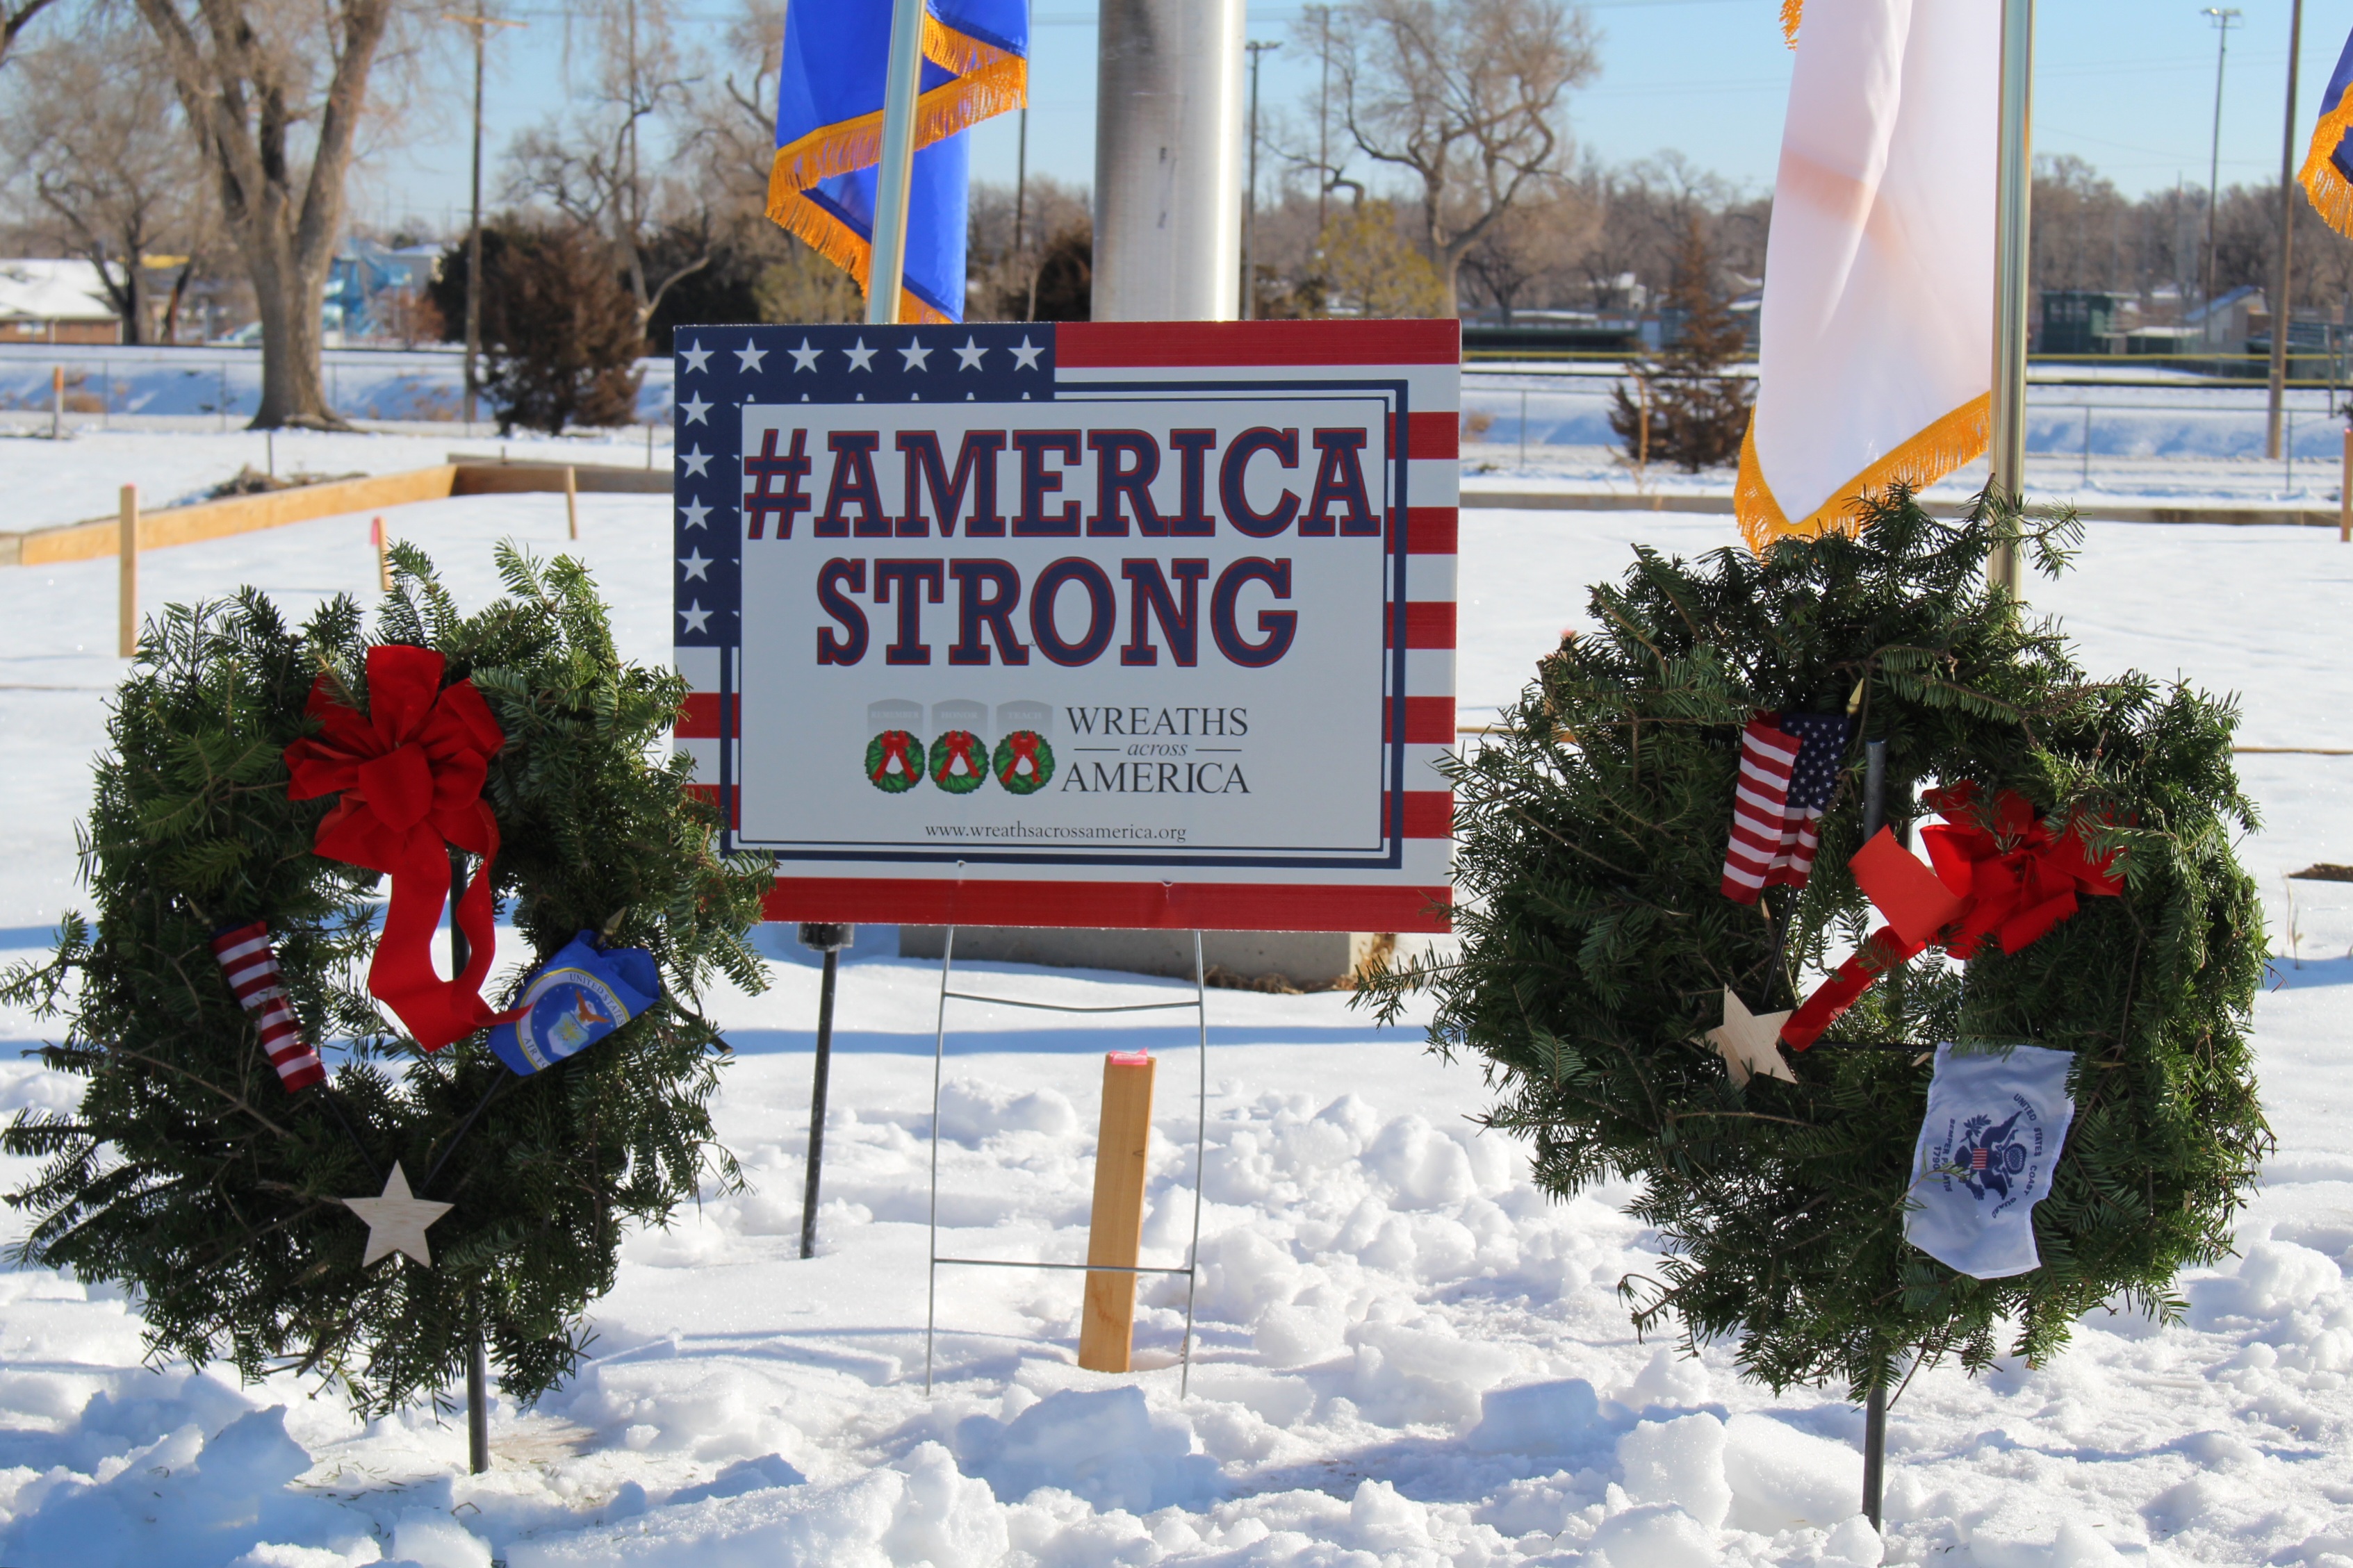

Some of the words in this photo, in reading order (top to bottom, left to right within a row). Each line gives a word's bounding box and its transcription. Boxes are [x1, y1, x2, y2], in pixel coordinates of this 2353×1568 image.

[744, 427, 1381, 540] #AMERICA
[817, 556, 1297, 668] STRONG
[1008, 711, 1042, 720] TEACH
[1065, 707, 1248, 736] WREATHS
[1127, 743, 1188, 757] across
[1060, 761, 1252, 793] AMERICA
[925, 820, 1187, 843] www.wreathsacrossamerica.org
[570, 973, 604, 994] UNITED
[602, 993, 625, 1025] STATES
[523, 1038, 537, 1056] AIR
[2013, 1093, 2037, 1121] UNITED
[1942, 1118, 1956, 1155] SEMPER
[2033, 1127, 2043, 1157] STATES
[1933, 1146, 1942, 1170] 1790
[1941, 1157, 1953, 1192] PATS
[2024, 1165, 2038, 1196] COAST
[1992, 1197, 2017, 1219] GUARD
